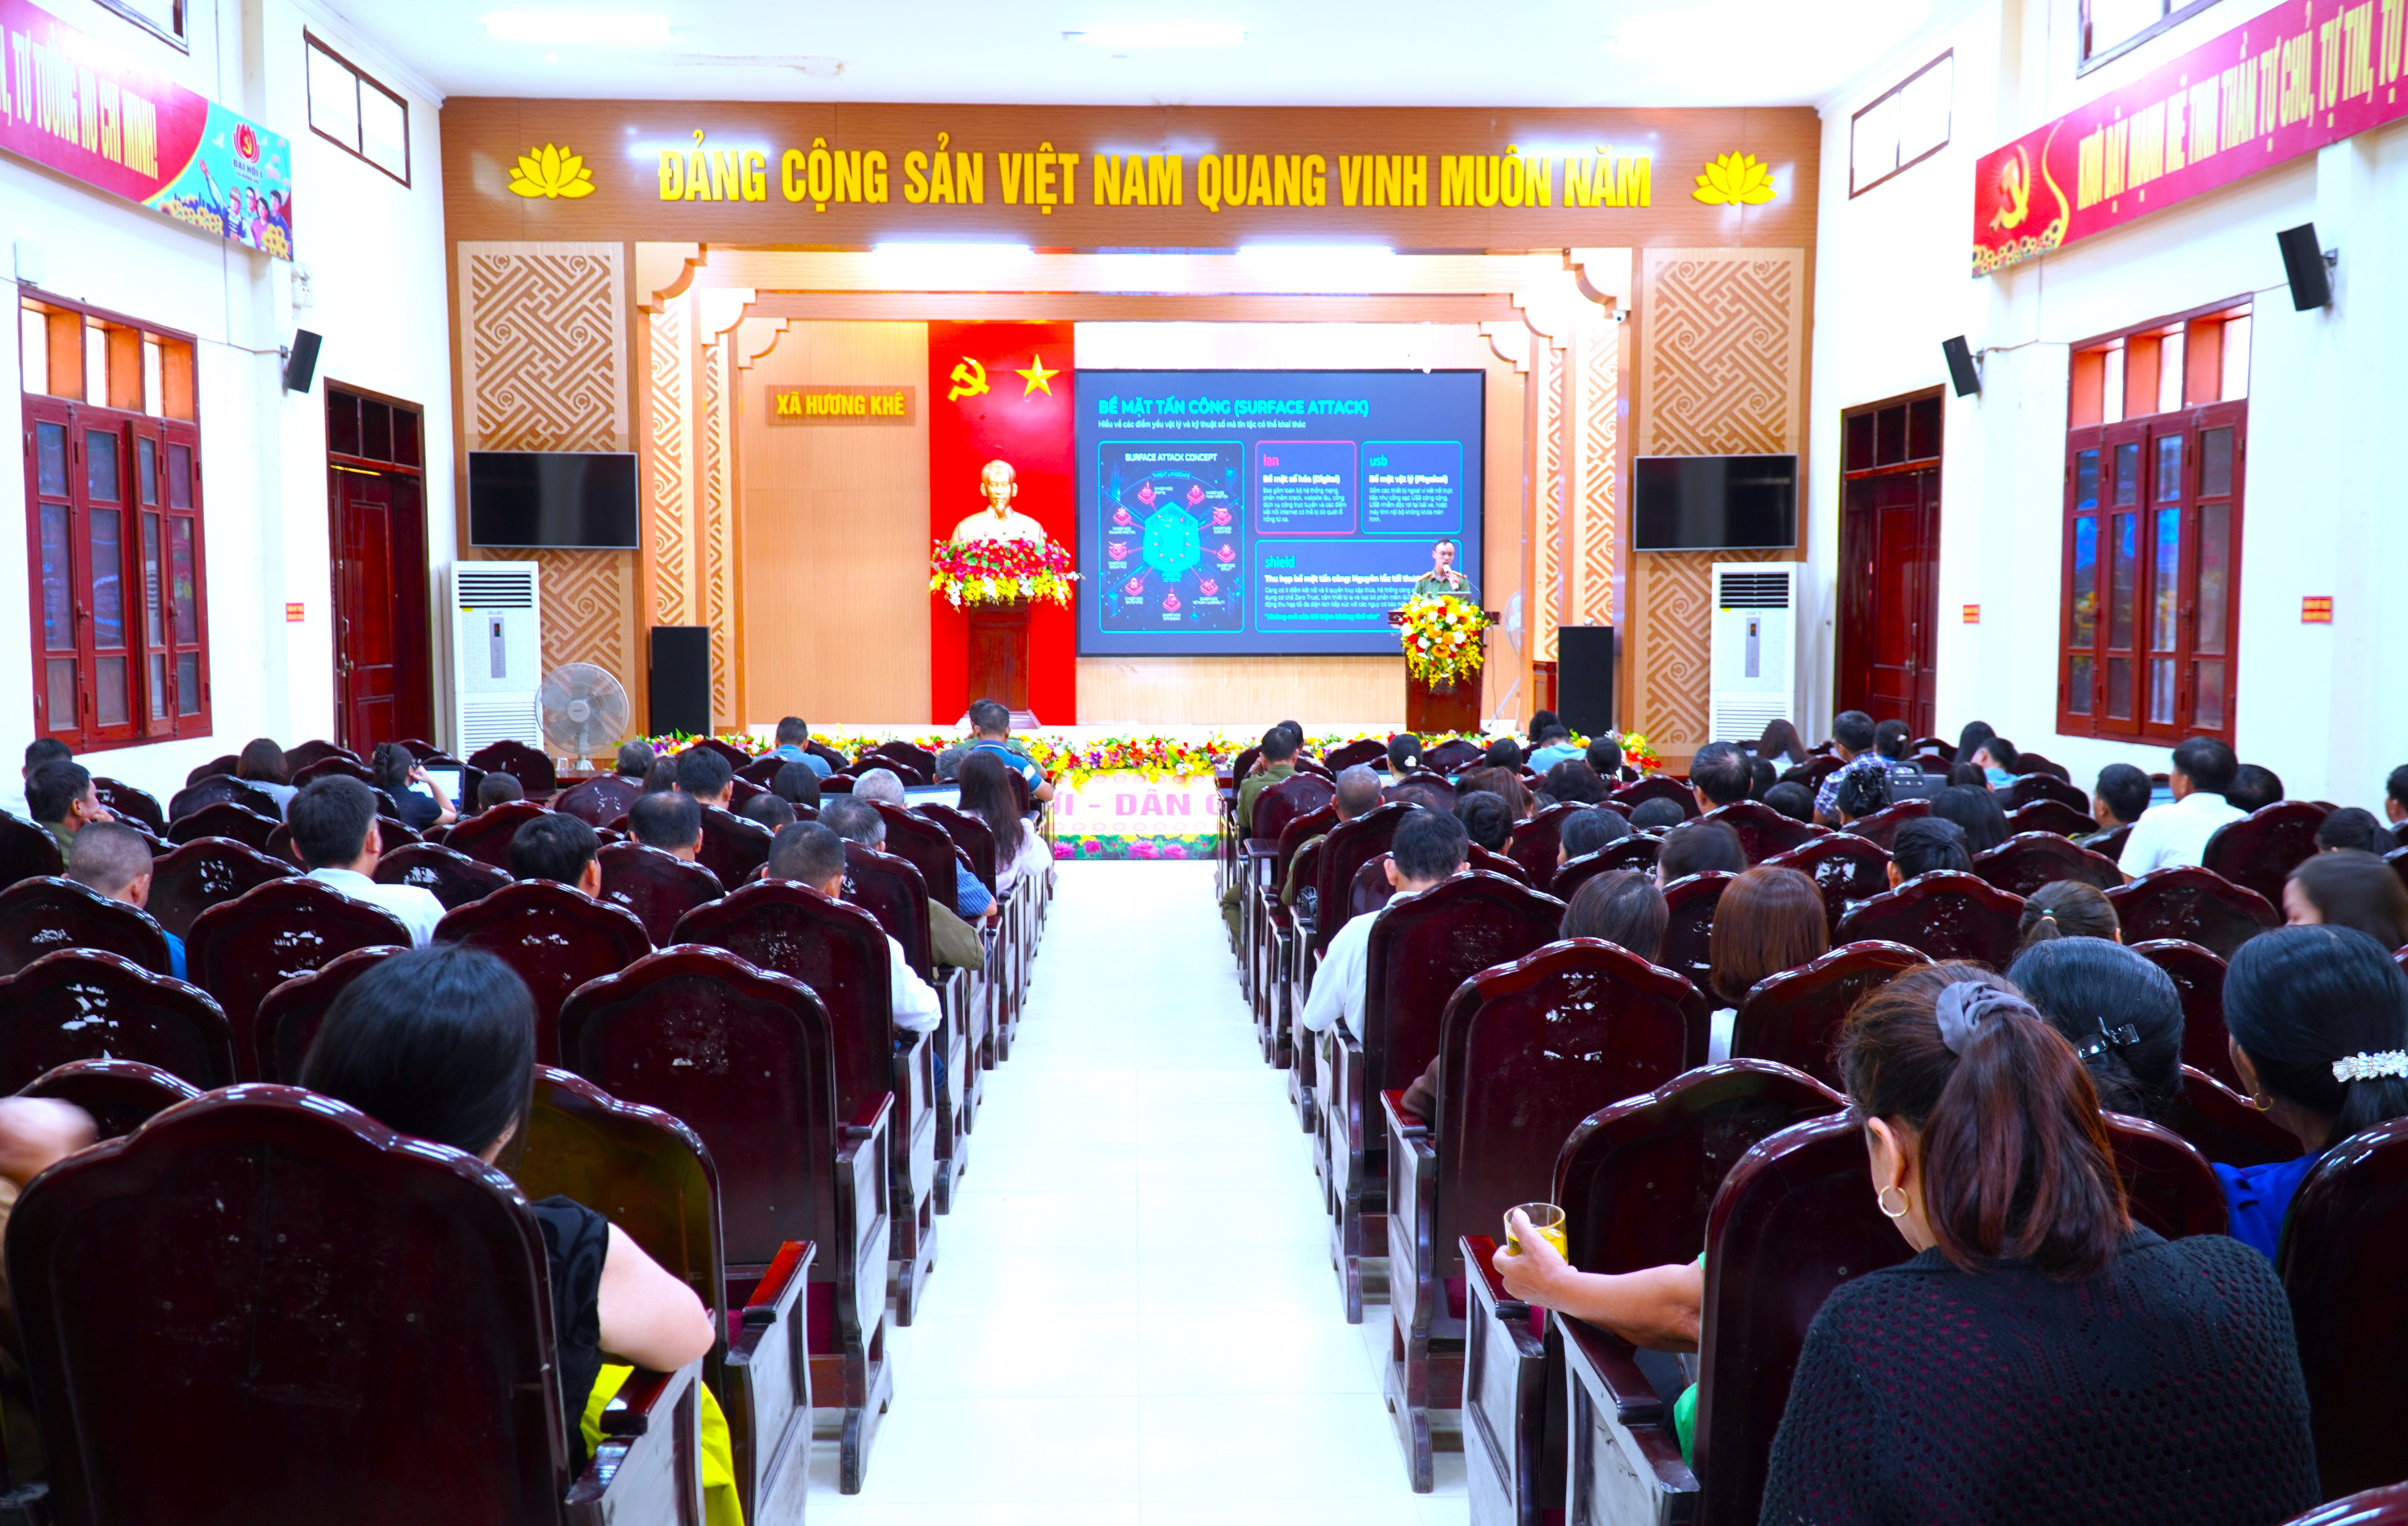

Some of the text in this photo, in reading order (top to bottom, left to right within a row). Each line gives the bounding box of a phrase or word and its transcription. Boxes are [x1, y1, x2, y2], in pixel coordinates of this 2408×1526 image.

[658, 129, 1651, 215] ĐẢNG CỘNG SẢN VIỆT NAM QUANG VINH MUÔN NĂM
[776, 391, 905, 416] XÃ HƯƠNG KHÊ
[1098, 396, 1369, 416] BỀ MẶT TẤN CÔNG (SURFACE ATTACK)
[1185, 453, 1217, 461] CONCEPT
[1263, 454, 1279, 466] lan
[1369, 454, 1388, 466] usb
[1265, 555, 1296, 568] shield
[1115, 788, 1190, 815] DÂN
